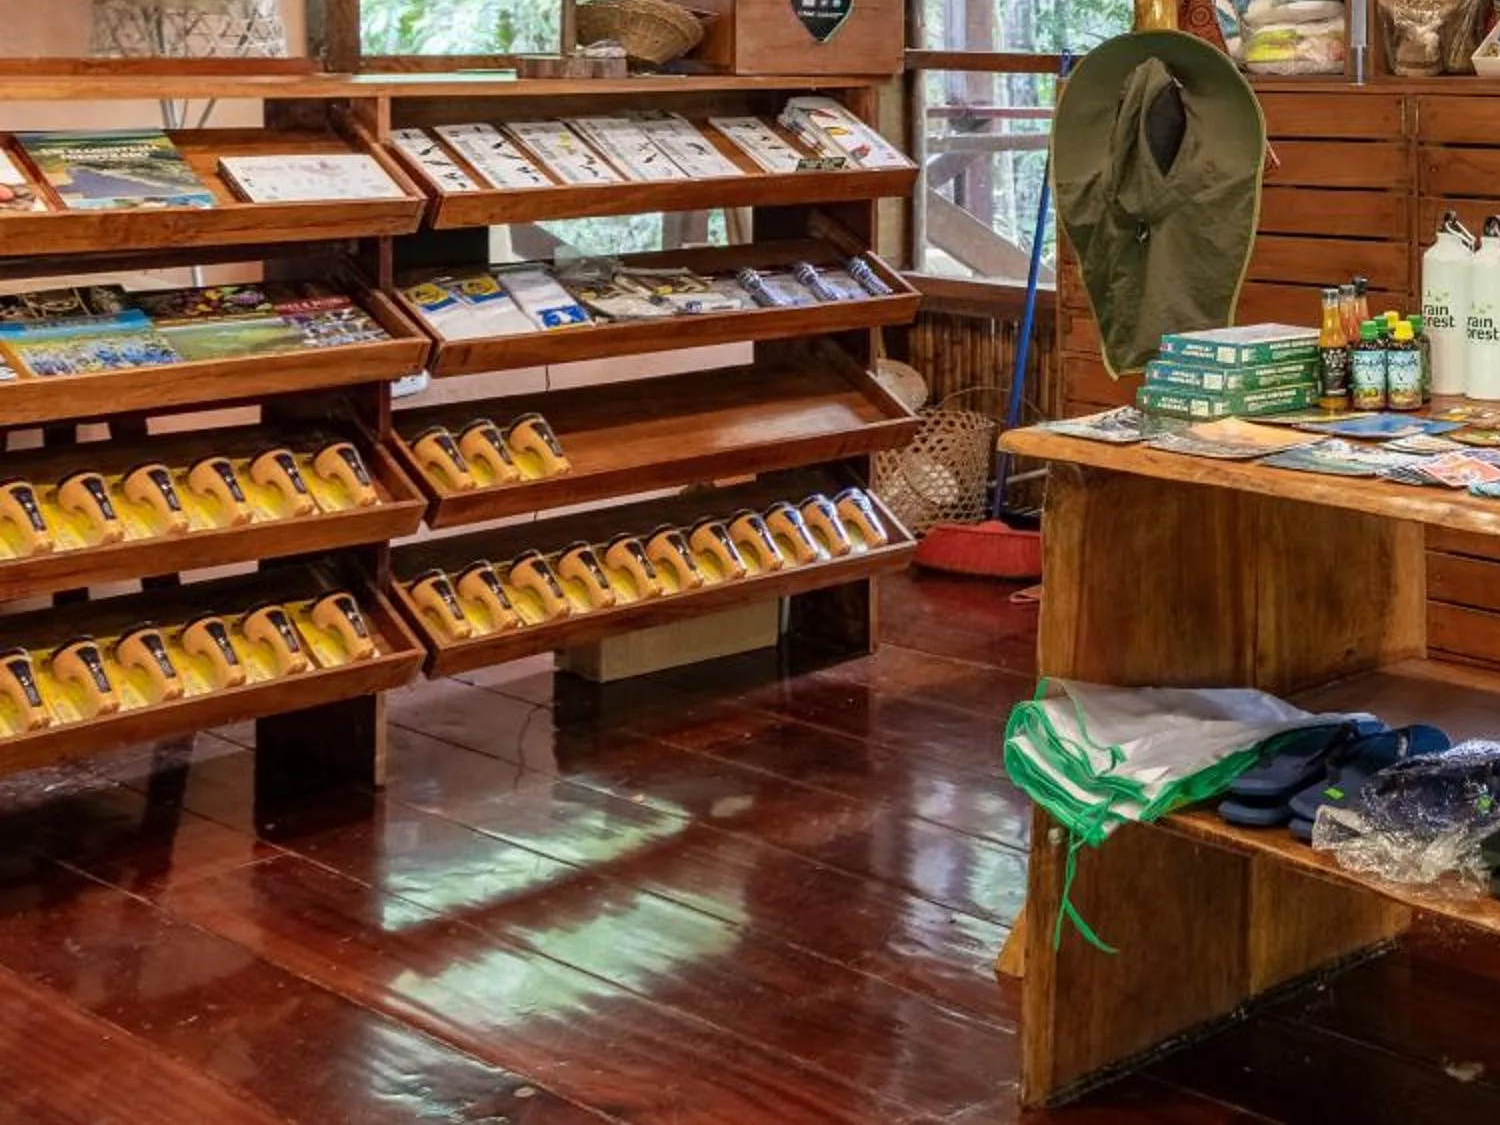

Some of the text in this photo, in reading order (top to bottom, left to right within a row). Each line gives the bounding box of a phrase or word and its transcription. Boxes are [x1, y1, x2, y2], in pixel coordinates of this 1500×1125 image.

[1424, 304, 1448, 315] rain
[1424, 314, 1456, 327] rest
[1467, 316, 1492, 328] rain
